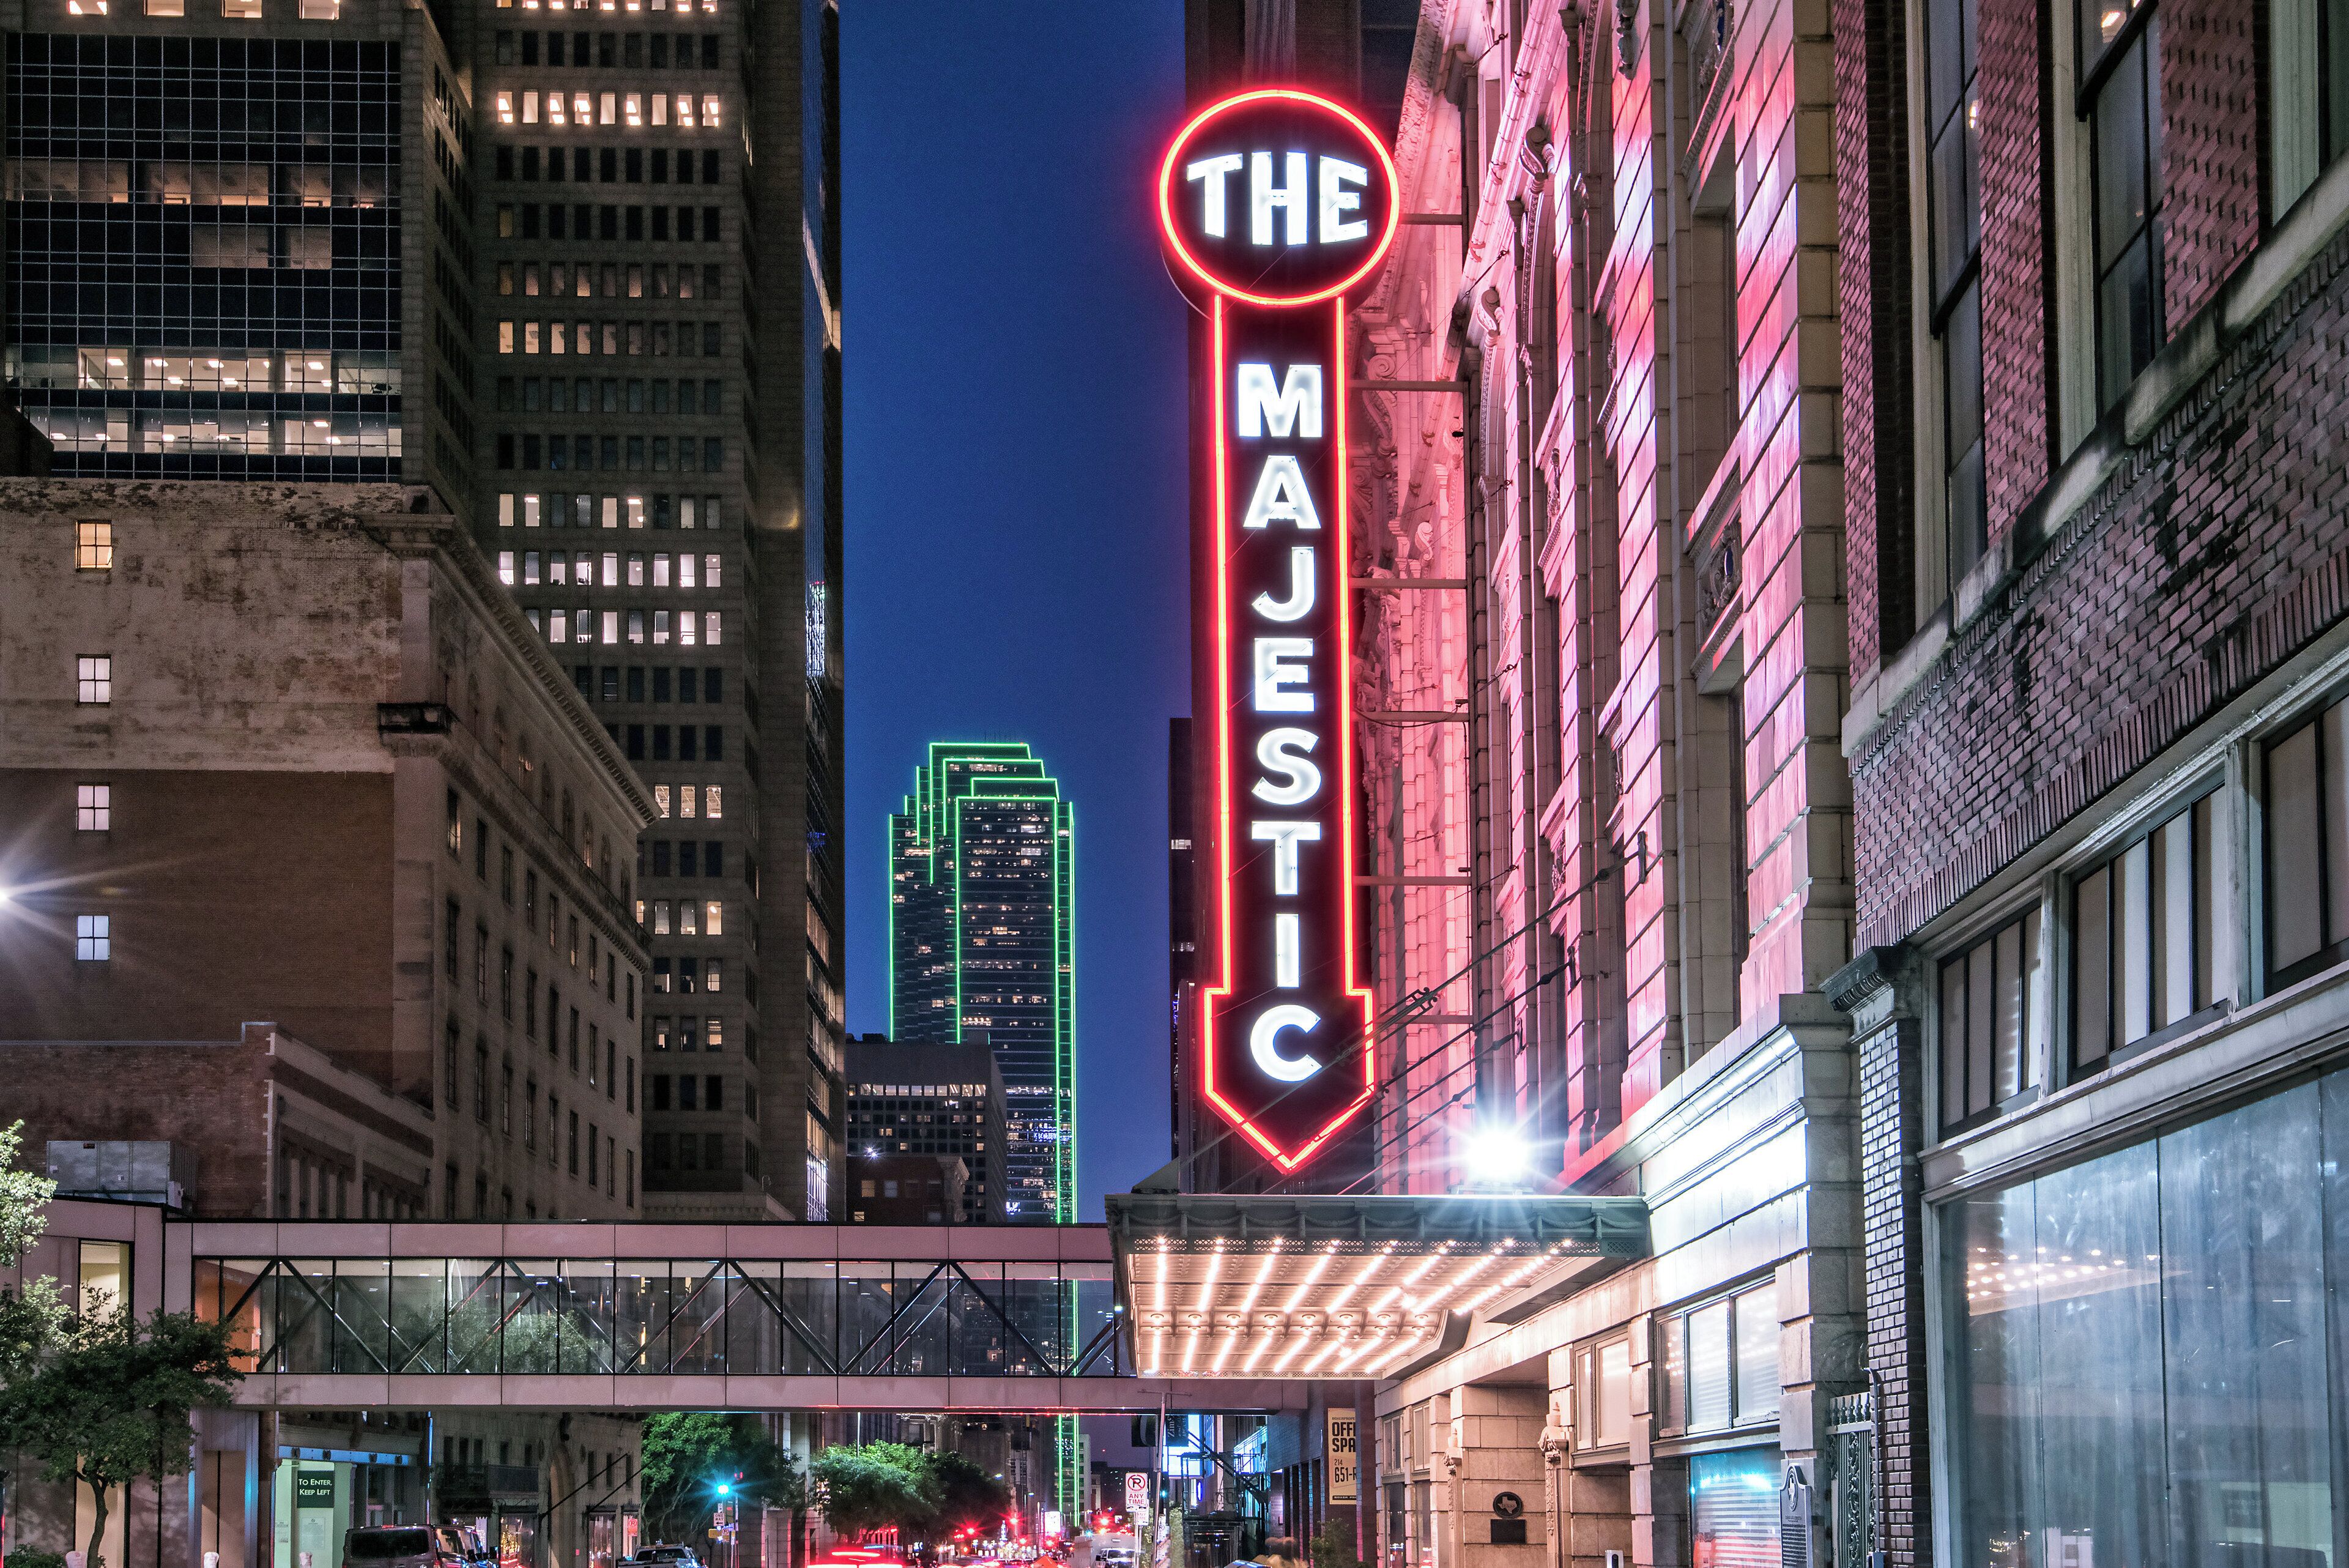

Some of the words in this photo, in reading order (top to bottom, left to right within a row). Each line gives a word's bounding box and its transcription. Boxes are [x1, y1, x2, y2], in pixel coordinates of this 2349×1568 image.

[1187, 151, 1368, 246] THE
[1238, 363, 1323, 1082] MAJESTIC
[1332, 1438, 1356, 1452] SPA
